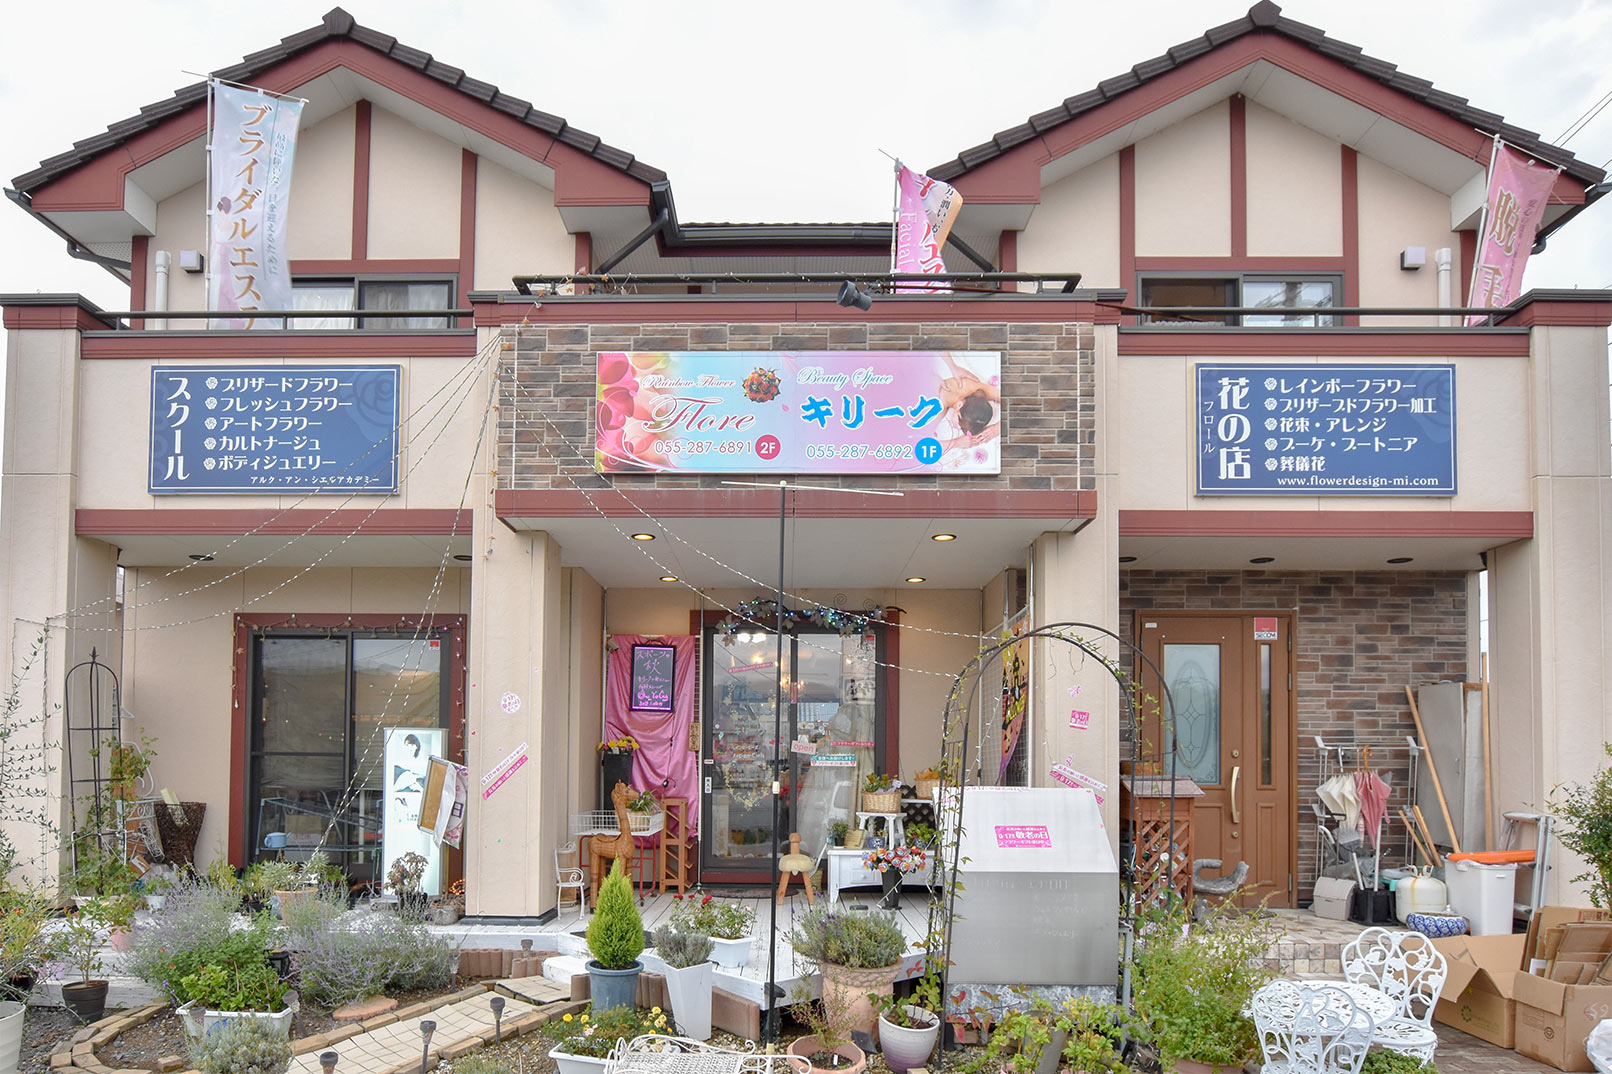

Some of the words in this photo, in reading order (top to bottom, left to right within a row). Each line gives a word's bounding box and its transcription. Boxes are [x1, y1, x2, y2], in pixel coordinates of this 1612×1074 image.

[898, 212, 918, 266] Facial
[642, 375, 694, 389] Rainbow
[696, 375, 736, 389] Flower
[797, 367, 849, 390] Beauty
[852, 367, 893, 389] Space
[1280, 378, 1417, 394] レインボーフラワー
[220, 396, 353, 412] フレッシュフラワー
[642, 394, 756, 433] Flore
[800, 395, 944, 430] キリーク
[163, 376, 192, 481] スクール
[219, 416, 323, 431] アートフラワー
[1203, 401, 1216, 455] フロール
[1217, 376, 1251, 481] 花の店
[1280, 416, 1387, 433] 花束・アレンジ
[219, 435, 321, 451] カルトナージュ
[655, 441, 752, 455] 055-287-6891
[760, 441, 776, 455] 2F
[1280, 436, 1419, 452] ブーケ・ブートニア
[806, 444, 913, 459] 055-287-6892
[921, 445, 937, 459] 1F
[1280, 456, 1326, 472] 葬儀花
[1277, 475, 1439, 488] www.flowerdesign-mi.com
[1255, 632, 1276, 640] SECOM
[643, 659, 662, 675] 秋
